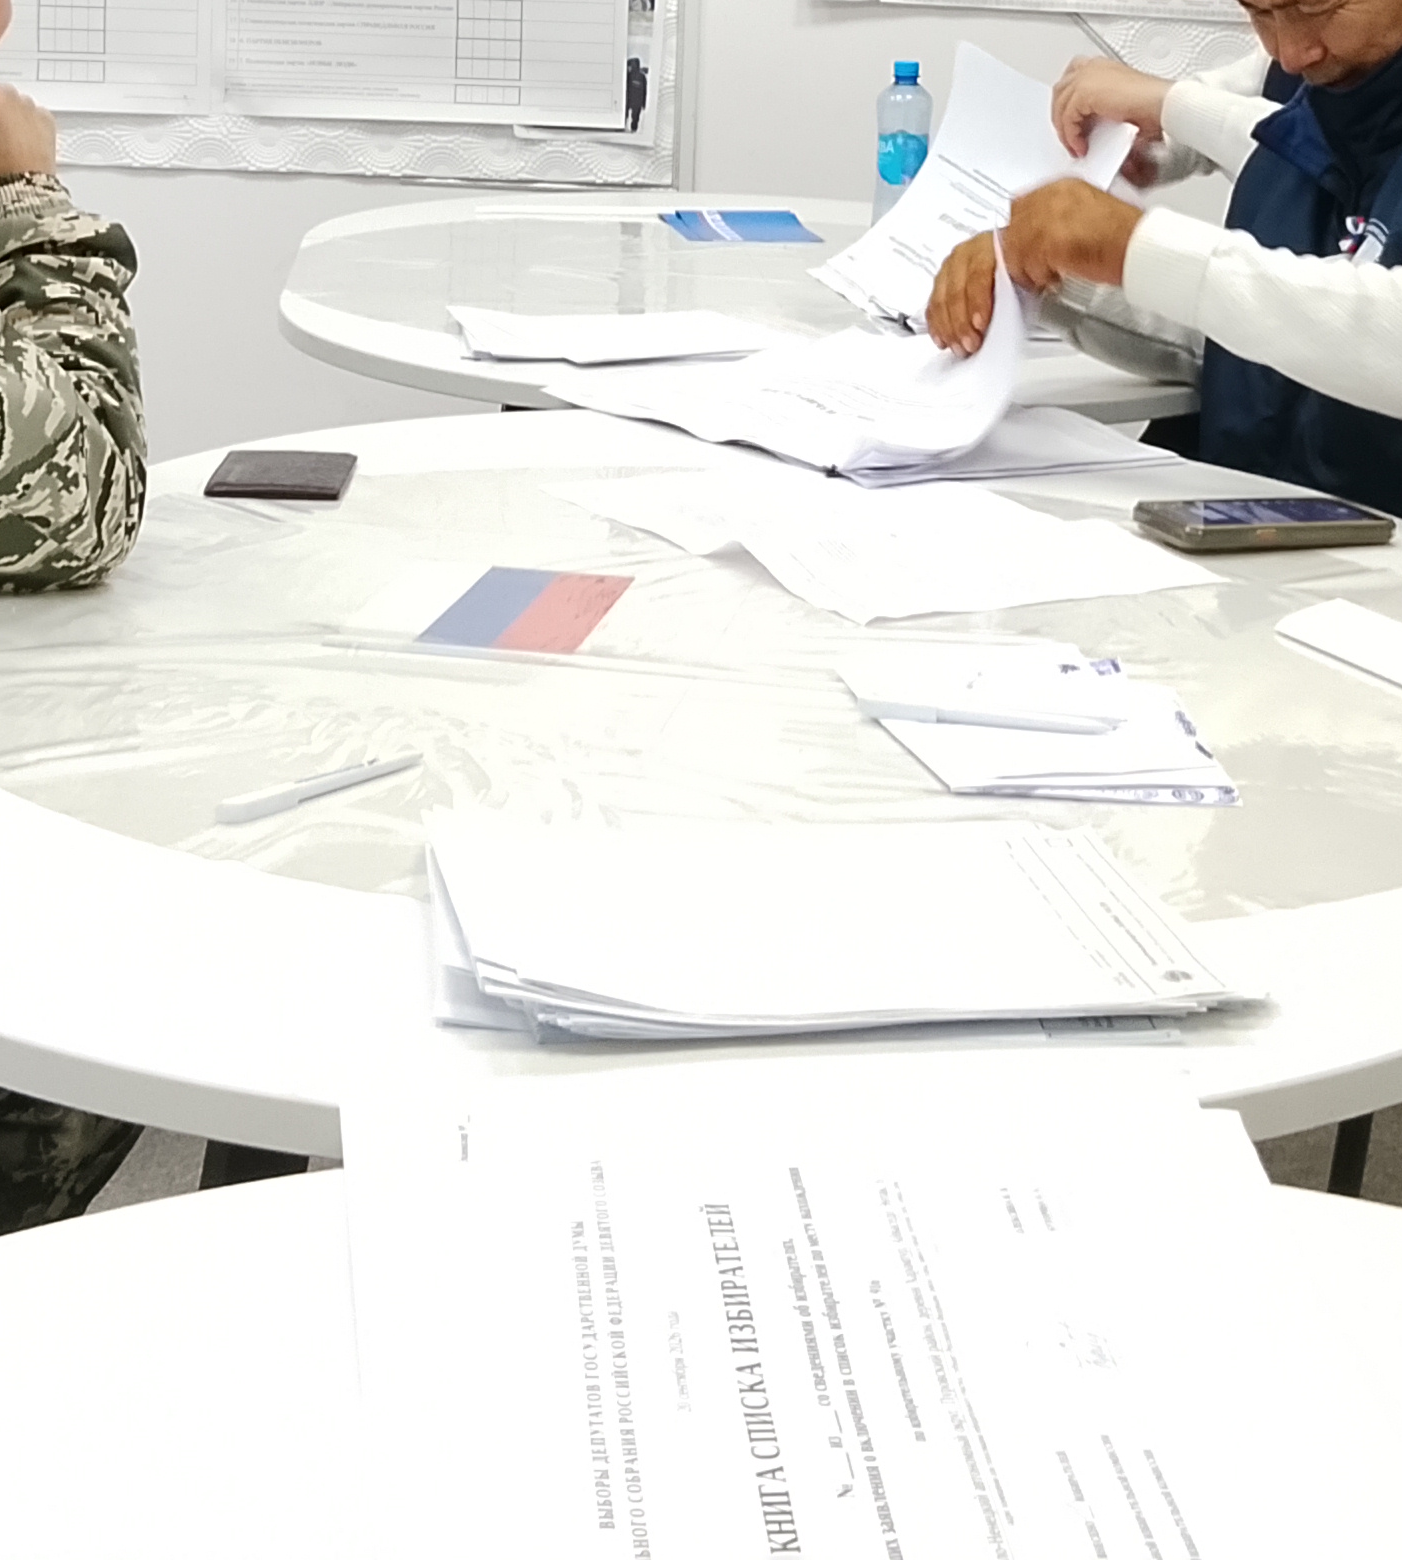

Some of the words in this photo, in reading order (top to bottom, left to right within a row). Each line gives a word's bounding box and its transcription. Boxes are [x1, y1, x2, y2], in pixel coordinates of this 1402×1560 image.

[570, 1220, 587, 1252] ДУМЫ
[593, 1200, 616, 1253] ДЕВЯТОГО
[600, 1256, 623, 1326] ФЕДЕРАЦИИ
[697, 1203, 759, 1354] ИЗБИРАТЕЛЕЙ
[793, 1304, 812, 1318] об
[809, 1263, 840, 1331] избирателей
[571, 1255, 600, 1380] ГОСУДАРСТВЕННОЙ
[667, 1332, 685, 1355] 2026
[607, 1331, 633, 1424] РОССИЙСКОЙ
[670, 1357, 690, 1401] сентября
[800, 1320, 828, 1392] сведениями
[831, 1334, 853, 1376] список
[842, 1378, 855, 1386] в
[734, 1361, 781, 1460] СПИСКА
[816, 1394, 832, 1407] со
[843, 1389, 876, 1453] включении
[889, 1352, 923, 1429] избирательному
[586, 1384, 610, 1465] ДЕПУТАТОВ
[828, 1435, 843, 1448] из
[620, 1428, 645, 1503] СОБРАНИЯ
[836, 1483, 856, 1498] №
[594, 1468, 616, 1530] ВЫБОРЫ
[754, 1465, 802, 1554] КНИГА
[866, 1465, 897, 1534] заявления
